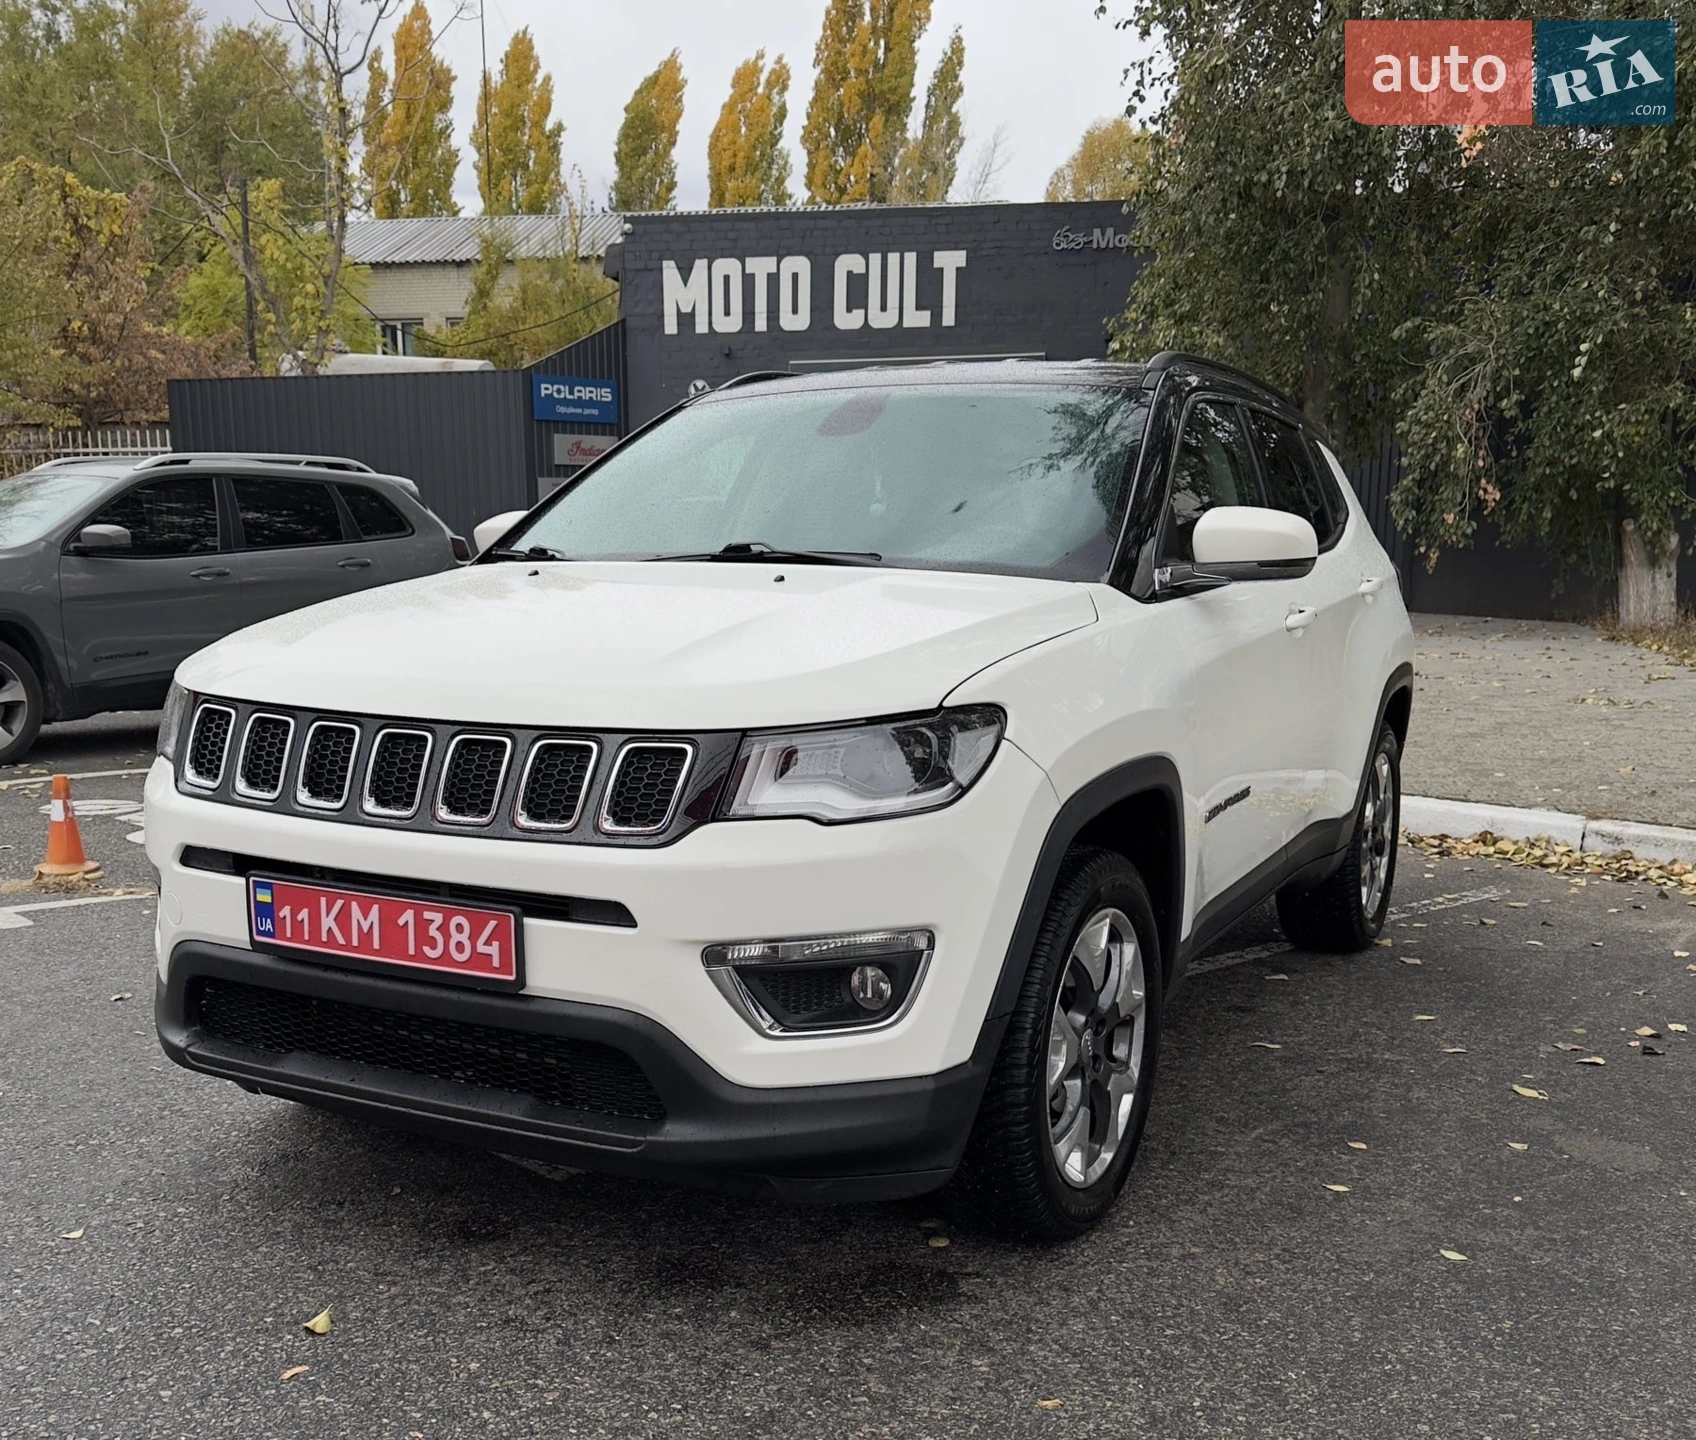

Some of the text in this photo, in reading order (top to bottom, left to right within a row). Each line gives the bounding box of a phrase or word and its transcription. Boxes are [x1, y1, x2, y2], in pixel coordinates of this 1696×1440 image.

[662, 250, 967, 335] MOTO CULT
[541, 383, 612, 401] POLARIS
[257, 916, 273, 933] UA
[397, 909, 500, 968] 1384
